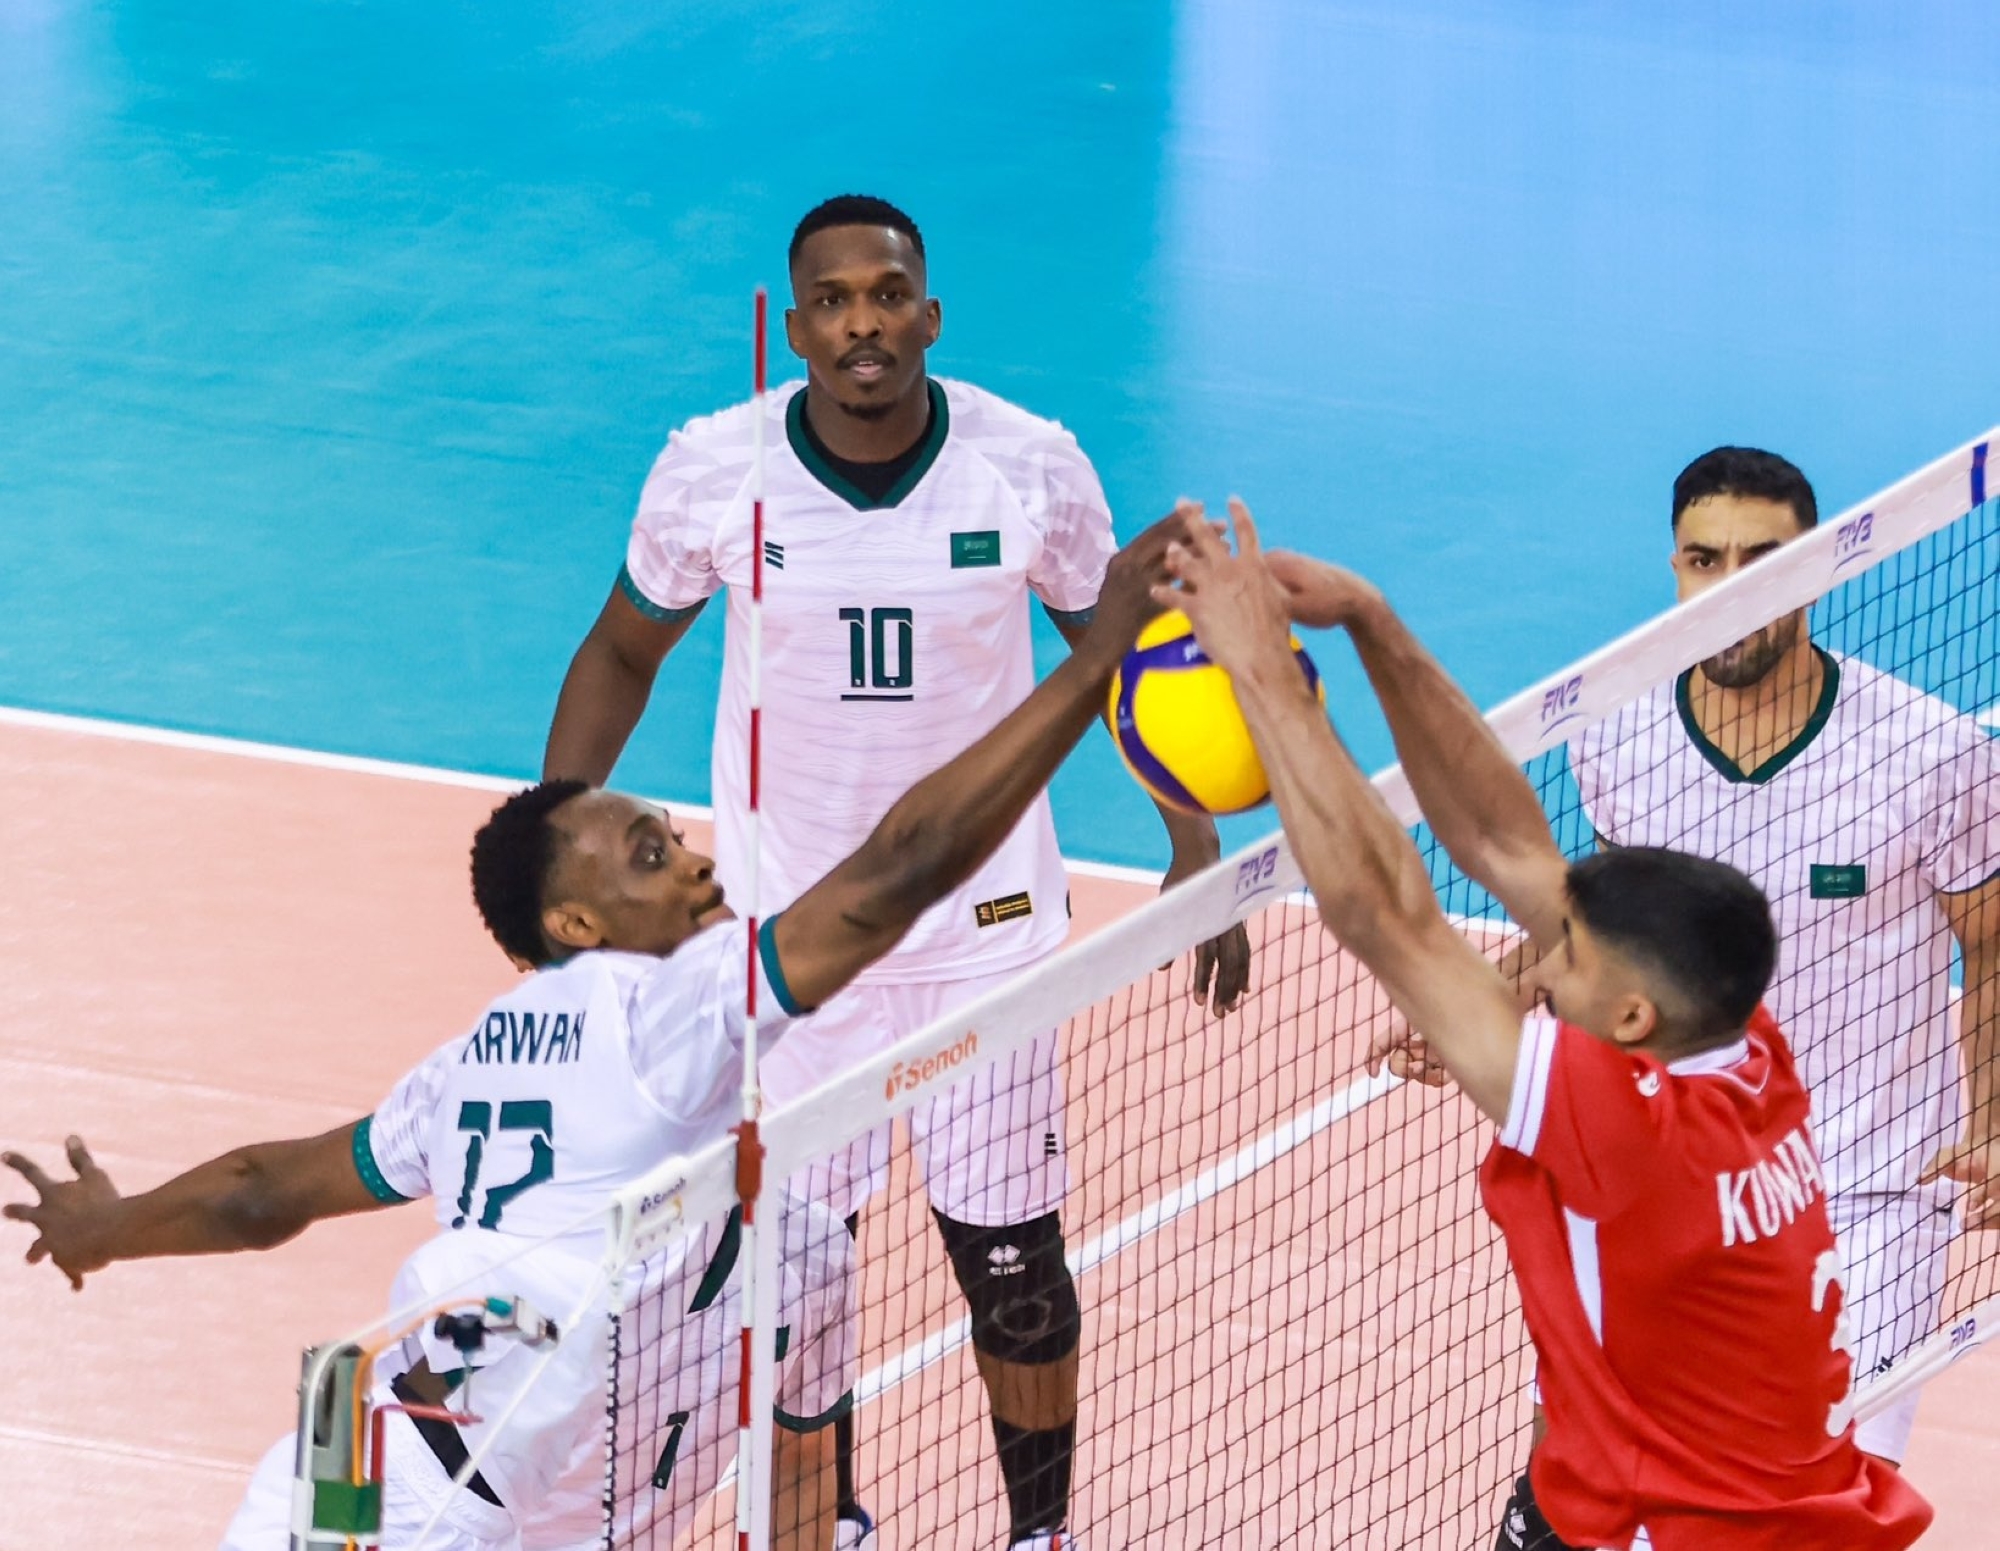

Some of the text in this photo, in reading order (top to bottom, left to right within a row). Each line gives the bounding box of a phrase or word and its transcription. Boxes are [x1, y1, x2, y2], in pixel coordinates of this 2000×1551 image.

[838, 607, 913, 688] 10
[904, 1030, 978, 1090] Senoh
[452, 1100, 554, 1231] 17
